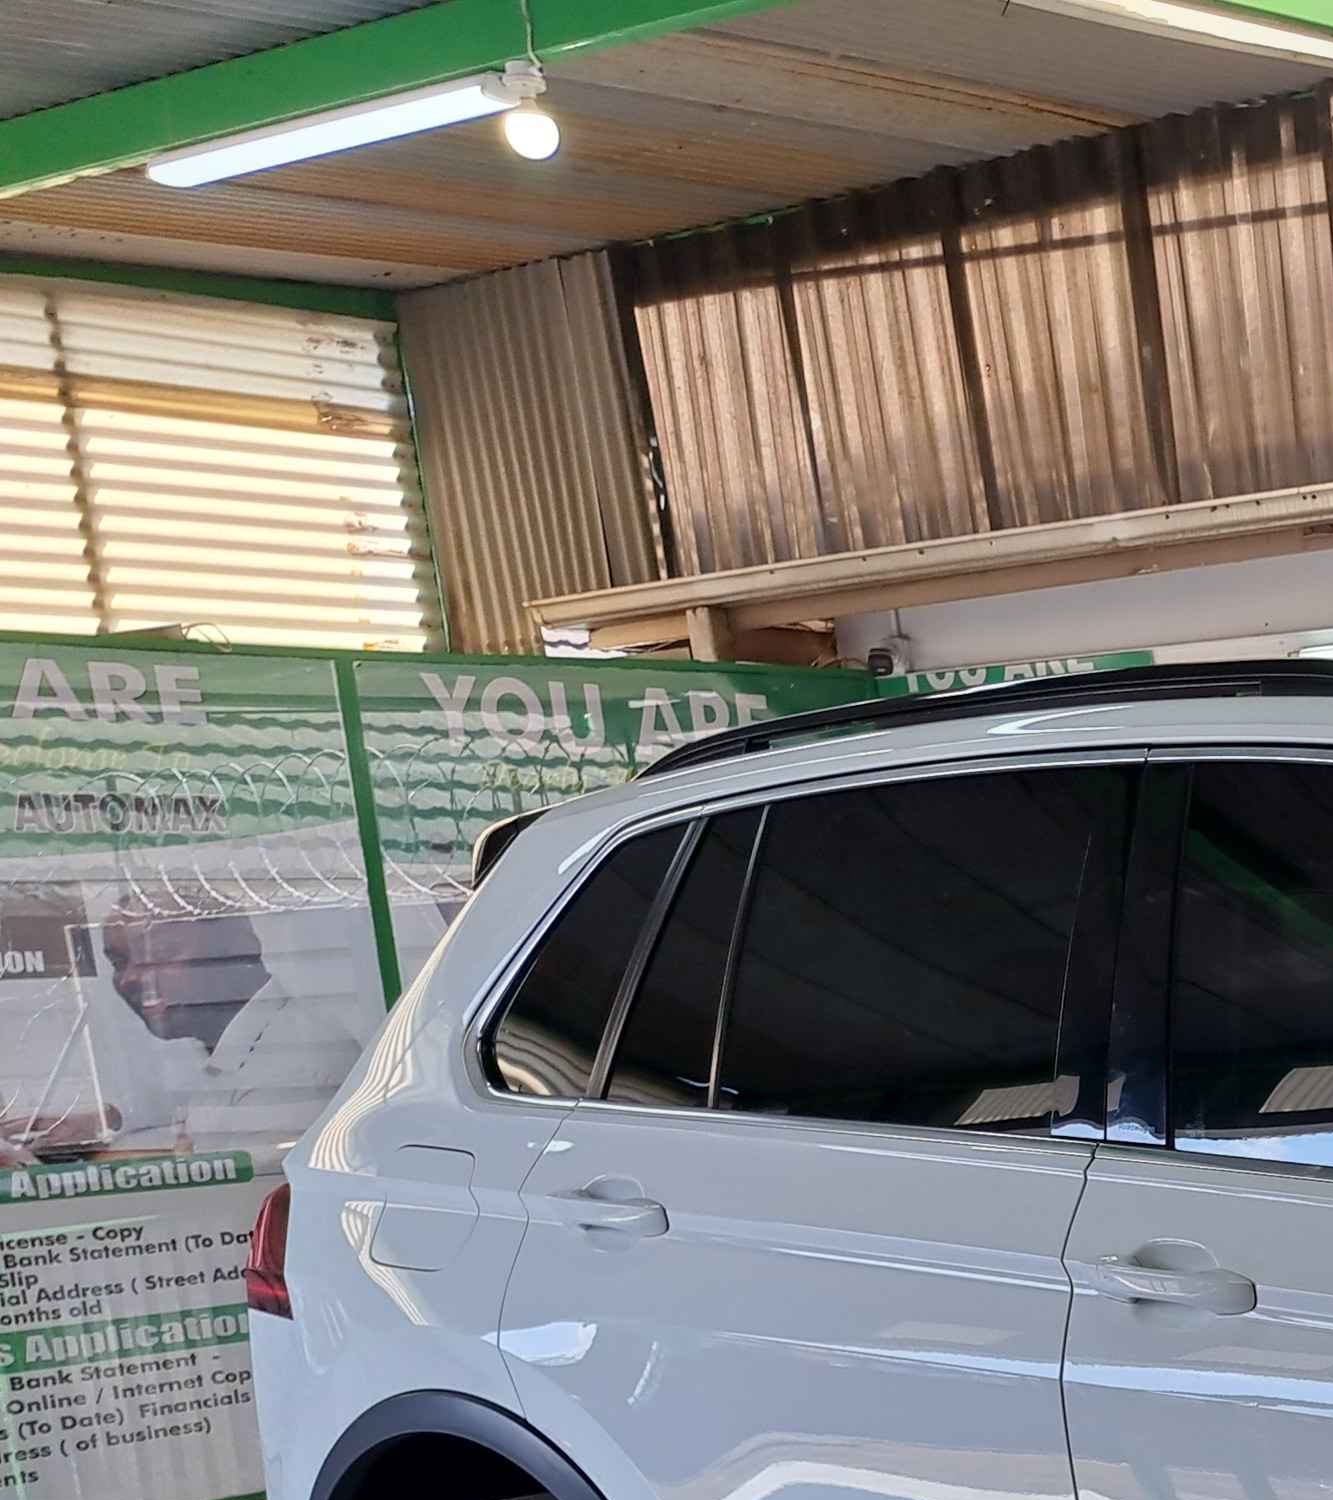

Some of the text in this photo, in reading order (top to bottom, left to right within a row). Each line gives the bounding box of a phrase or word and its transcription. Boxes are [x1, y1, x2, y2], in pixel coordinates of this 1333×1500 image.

[10, 657, 207, 725] ARE
[419, 672, 607, 752] YOU
[14, 790, 230, 834] AUTOMAX
[0, 950, 46, 975] ON
[10, 1157, 237, 1199] Application
[3, 1248, 62, 1269] Bank
[69, 1238, 177, 1262] Statement
[184, 1234, 213, 1253] (To
[92, 1226, 144, 1243] Copy
[0, 1271, 39, 1291] Slip
[36, 1283, 124, 1304] Address
[144, 1271, 206, 1290] Street
[0, 1299, 103, 1326] onths old
[9, 1370, 73, 1391] Bank
[81, 1353, 197, 1382] Statement
[6, 1394, 87, 1415] Online
[113, 1375, 204, 1400] Internet
[18, 1420, 52, 1441] (To
[61, 1408, 125, 1431] Date)
[139, 1389, 251, 1419] Financials
[0, 1444, 52, 1465] ress
[76, 1433, 98, 1452] of
[106, 1416, 212, 1446] business)
